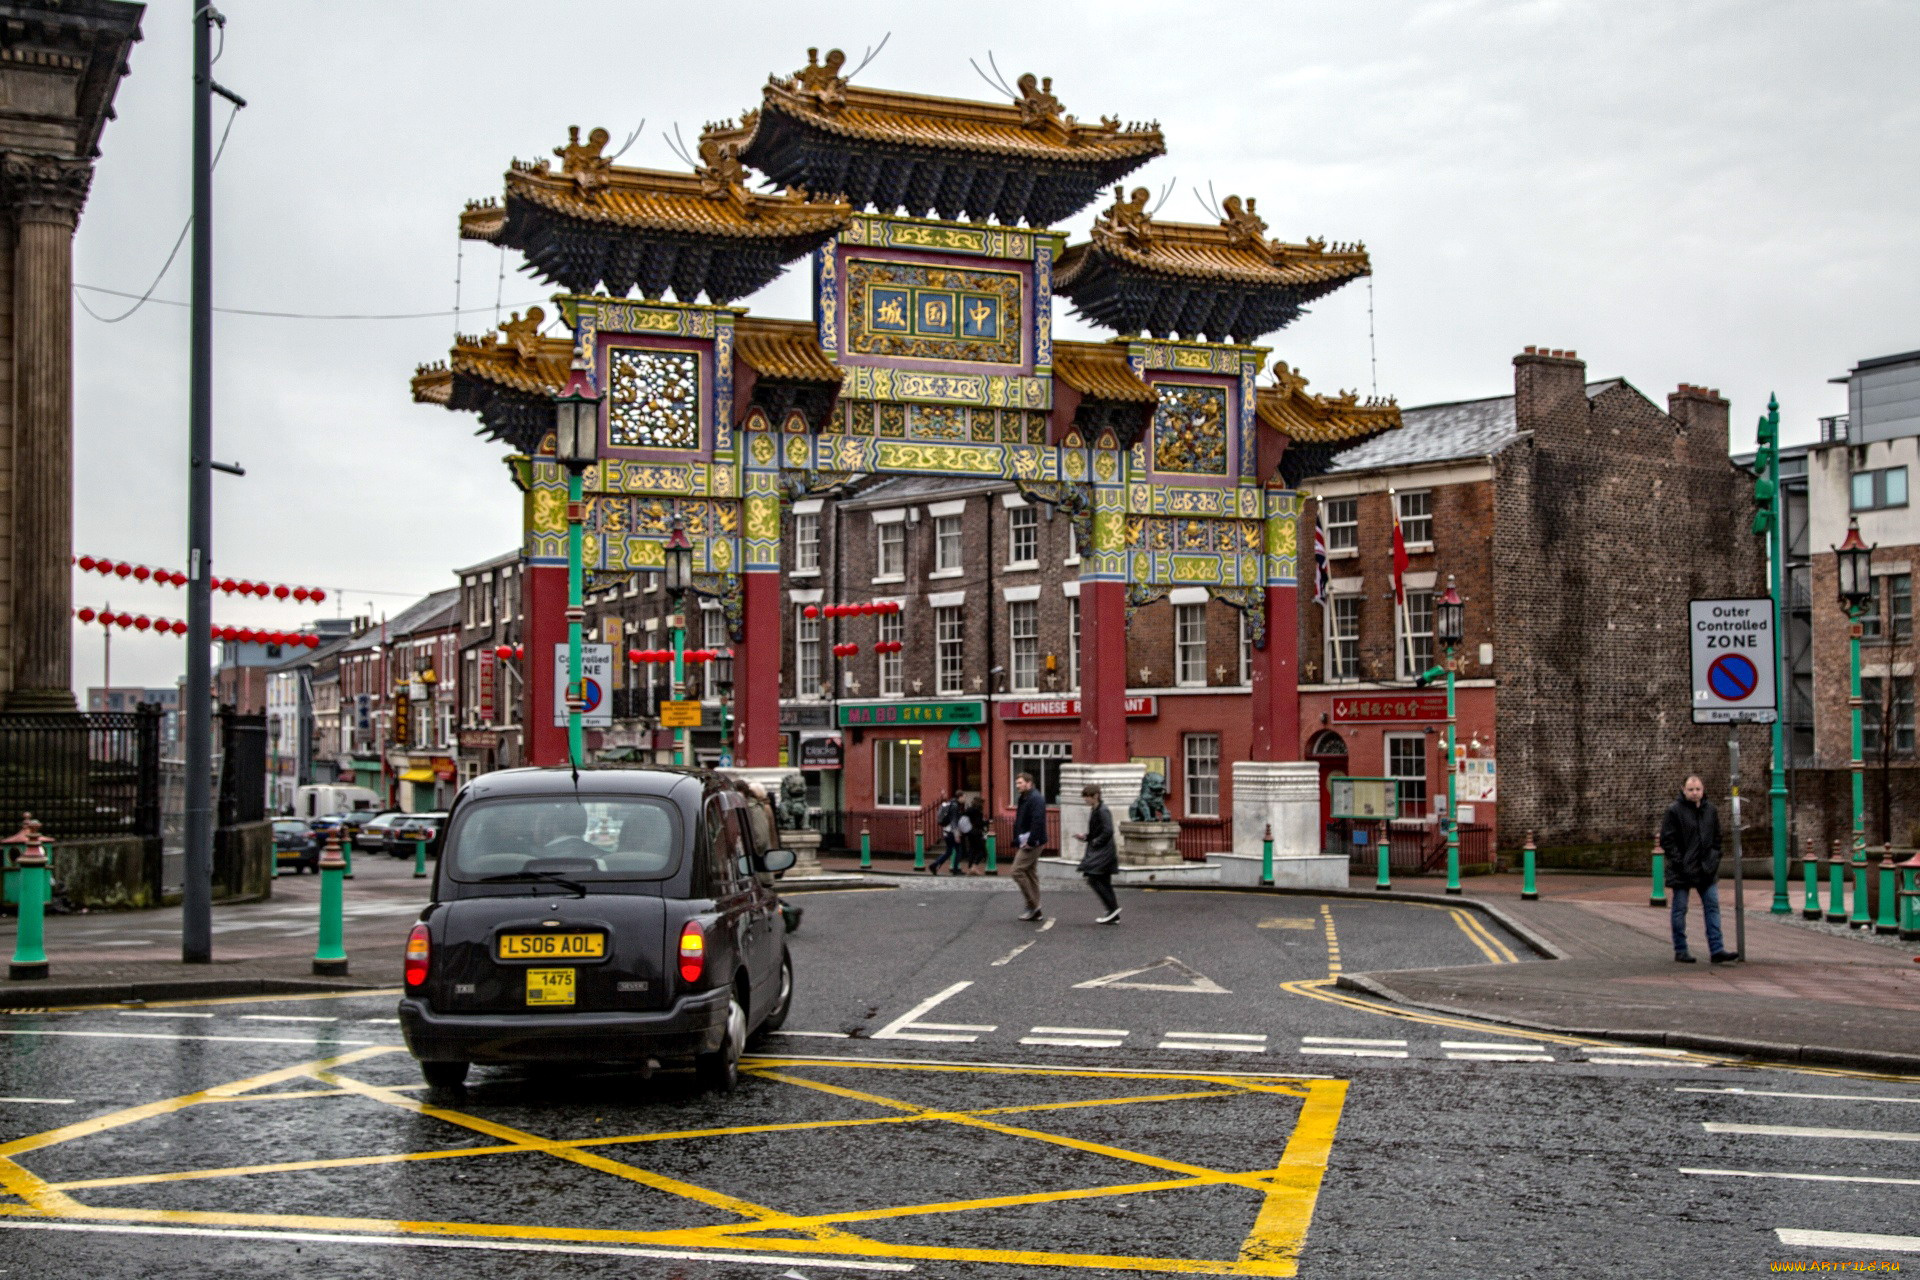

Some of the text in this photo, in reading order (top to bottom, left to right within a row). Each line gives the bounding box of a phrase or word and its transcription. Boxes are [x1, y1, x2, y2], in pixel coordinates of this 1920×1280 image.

[1712, 606, 1750, 618] Outer
[1696, 620, 1768, 632] Controlled
[1707, 635, 1758, 648] ZONE
[558, 655, 609, 663] Corolled
[1021, 701, 1068, 714] CHINESE
[848, 708, 871, 722] MA
[875, 707, 897, 722] BO
[508, 936, 595, 954] LS06 AOL
[542, 974, 572, 986] 1475
